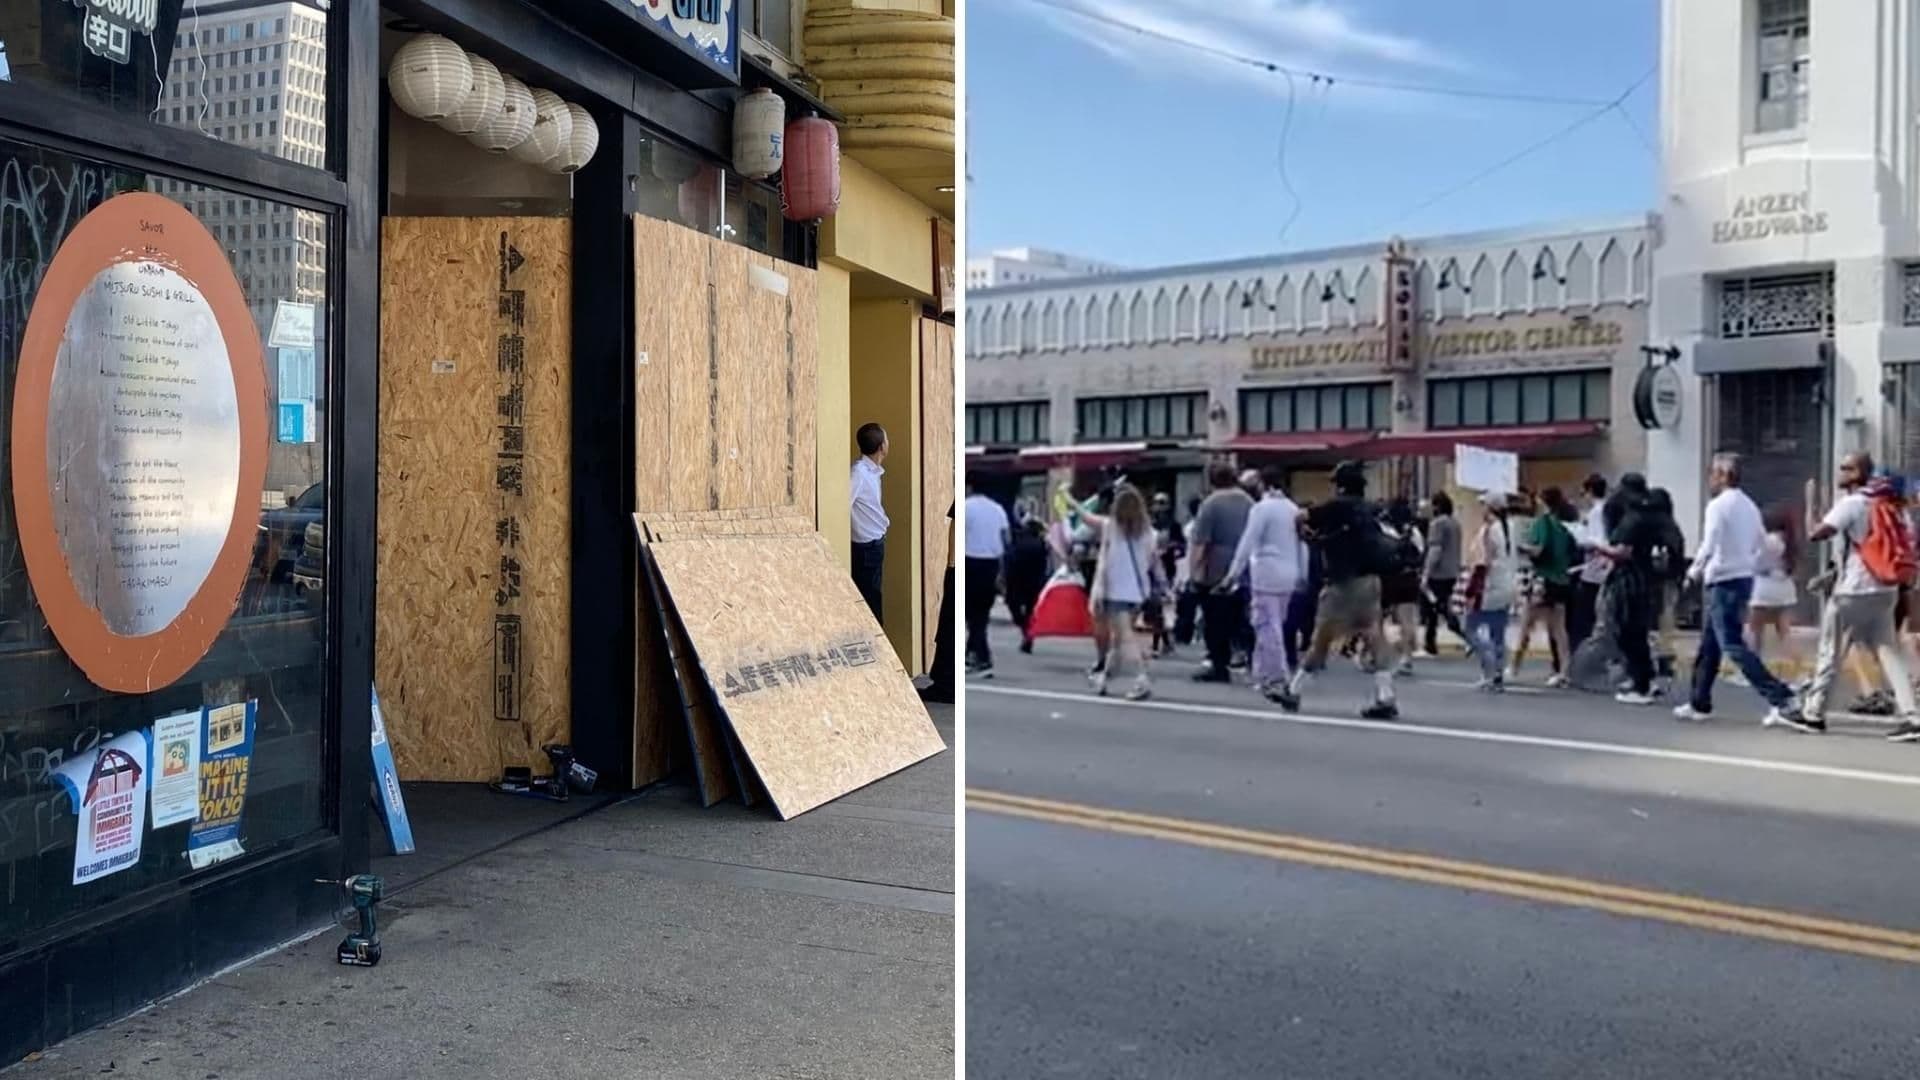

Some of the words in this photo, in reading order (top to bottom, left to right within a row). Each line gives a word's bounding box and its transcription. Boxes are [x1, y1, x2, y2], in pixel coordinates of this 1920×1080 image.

[89, 14, 127, 55] 辛口
[1733, 192, 1807, 218] ANZEN
[1712, 210, 1829, 244] HARDWARE
[141, 284, 163, 298] SUSHI
[1251, 343, 1314, 368] LITTLE
[1426, 329, 1518, 357] VISITOR
[1525, 321, 1623, 351] CENTER
[200, 757, 248, 778] IMAGINE
[96, 813, 132, 835] IMMIGRANTS
[77, 859, 108, 878] WELCOMES
